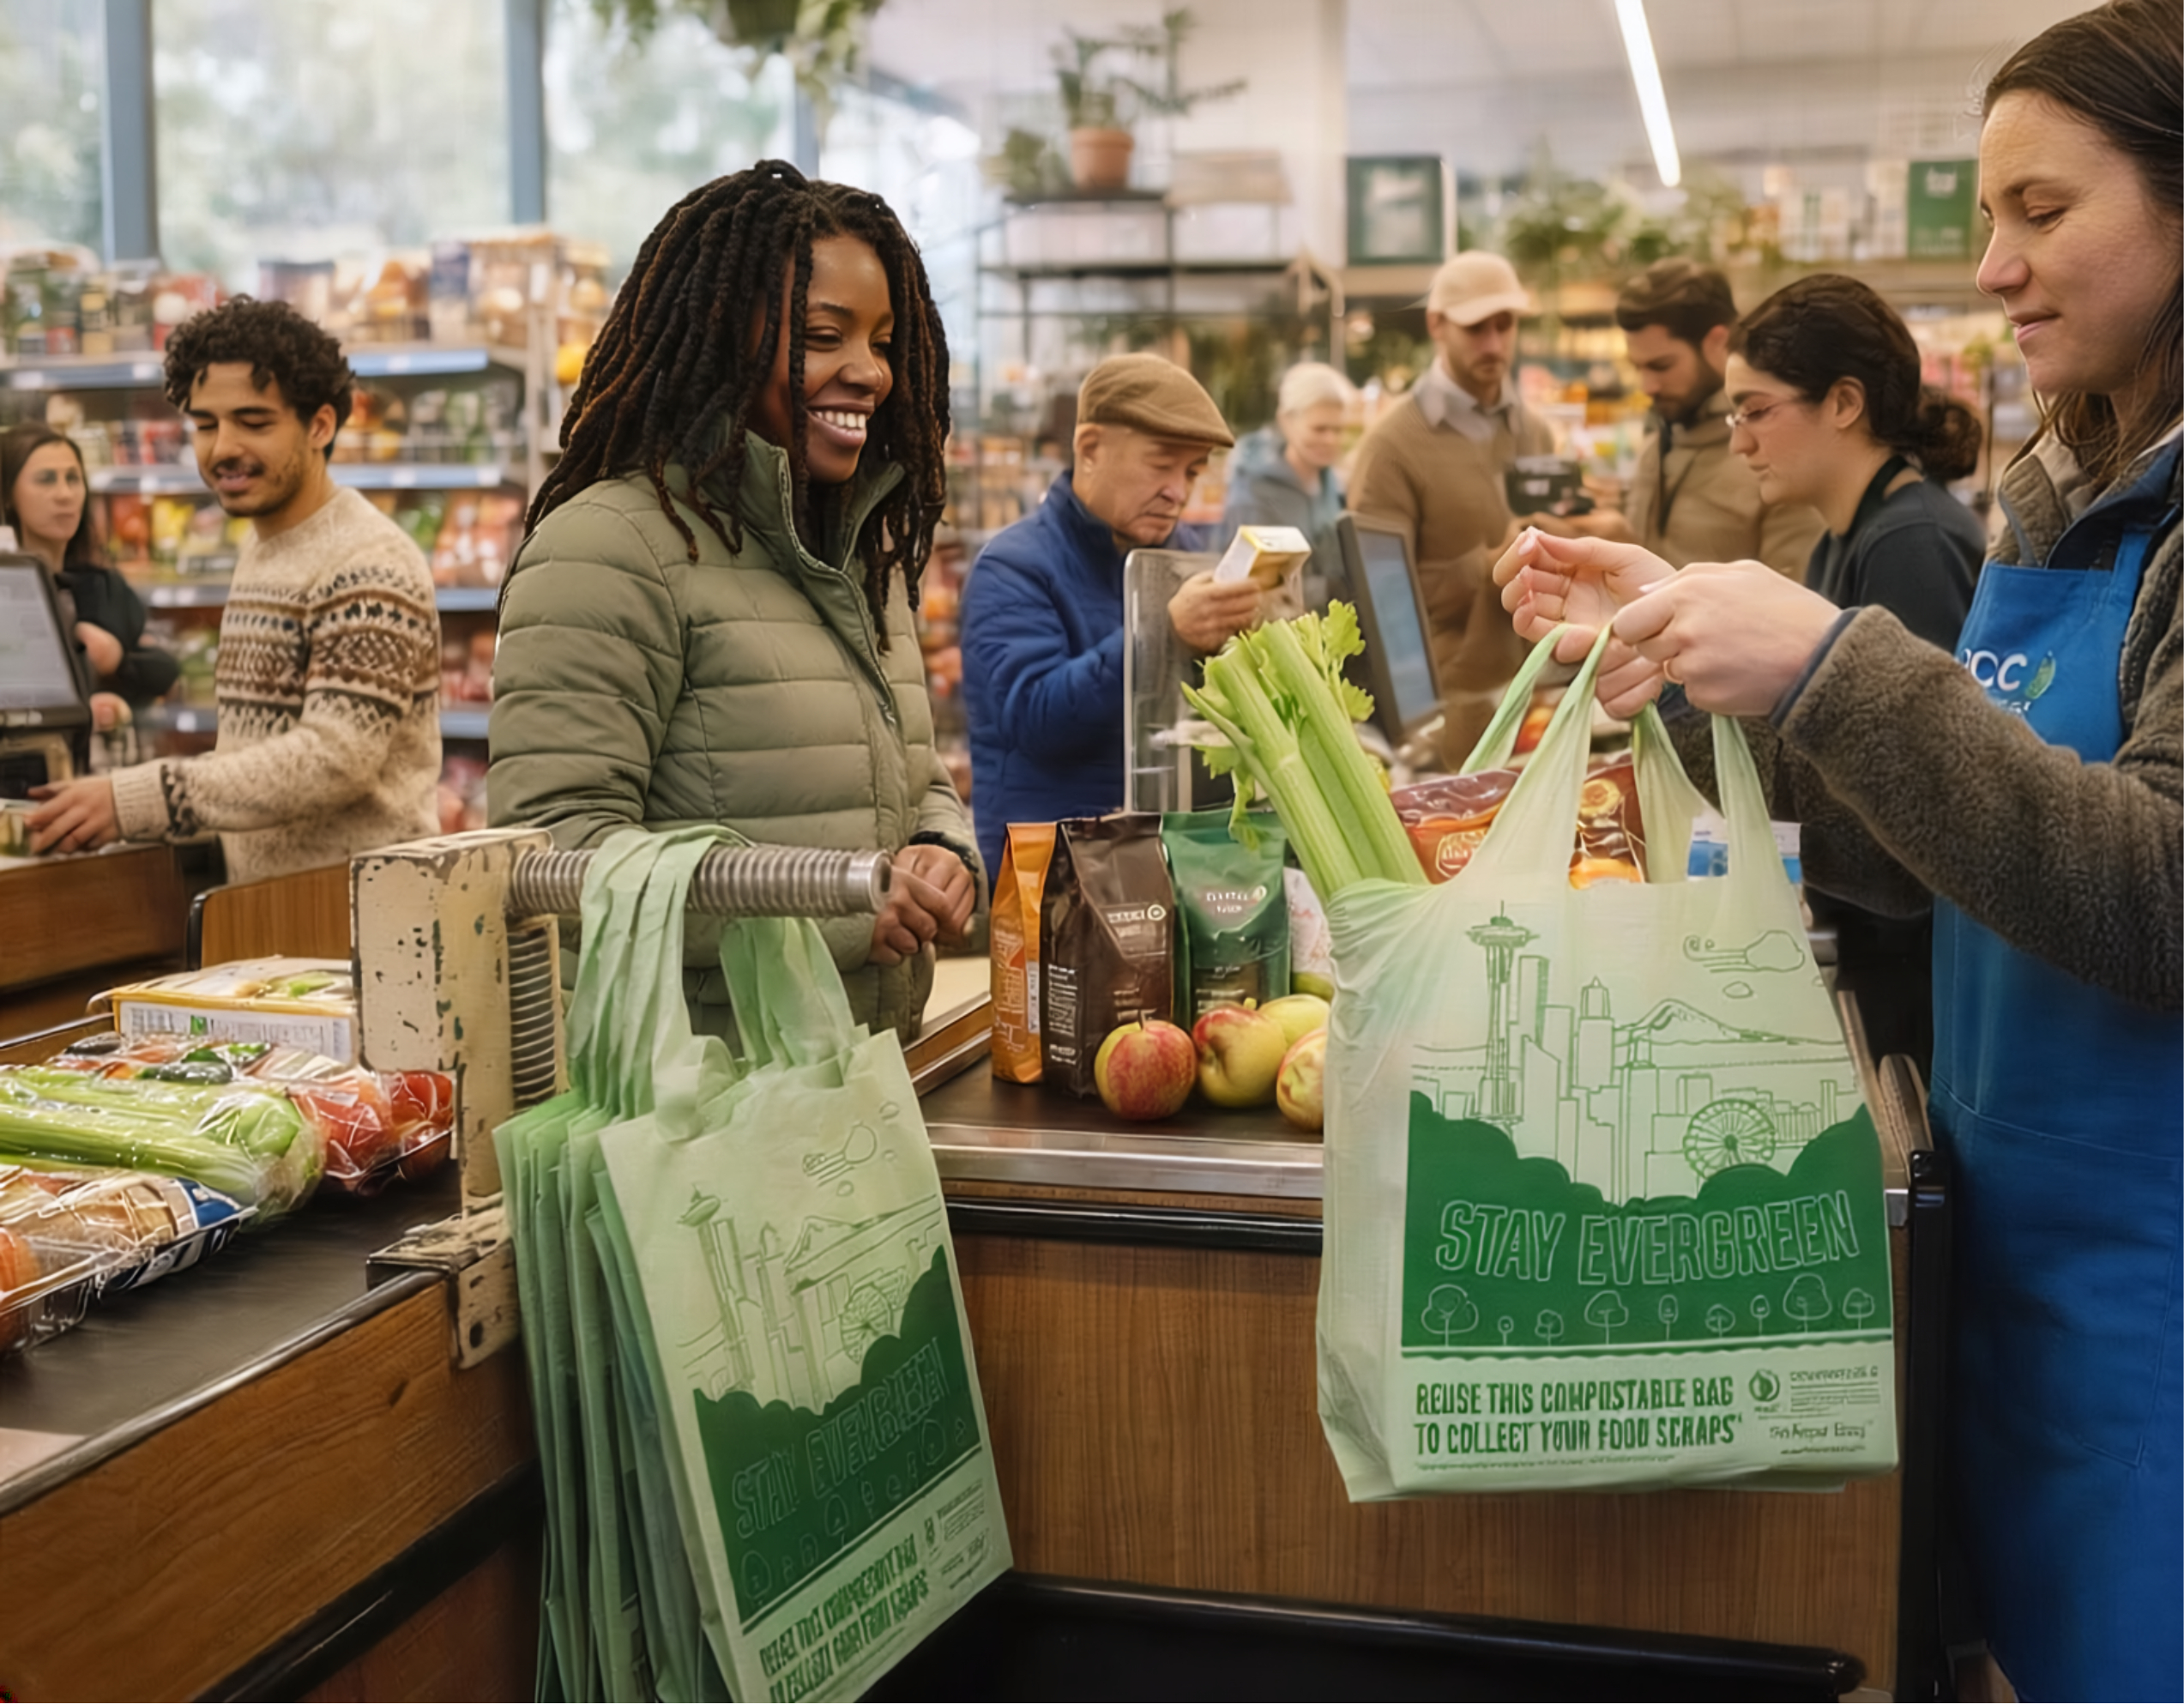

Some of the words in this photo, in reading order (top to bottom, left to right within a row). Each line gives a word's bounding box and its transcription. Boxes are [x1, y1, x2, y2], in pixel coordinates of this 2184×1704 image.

[1435, 1200, 1566, 1282] STAY
[1578, 1190, 1861, 1286] EVERGREEN
[1416, 1382, 1482, 1415] REUSE
[1486, 1382, 1534, 1415] THIS
[1692, 1375, 1734, 1407] BAG
[1414, 1422, 1440, 1455] TO
[1447, 1421, 1537, 1453] COLLECT
